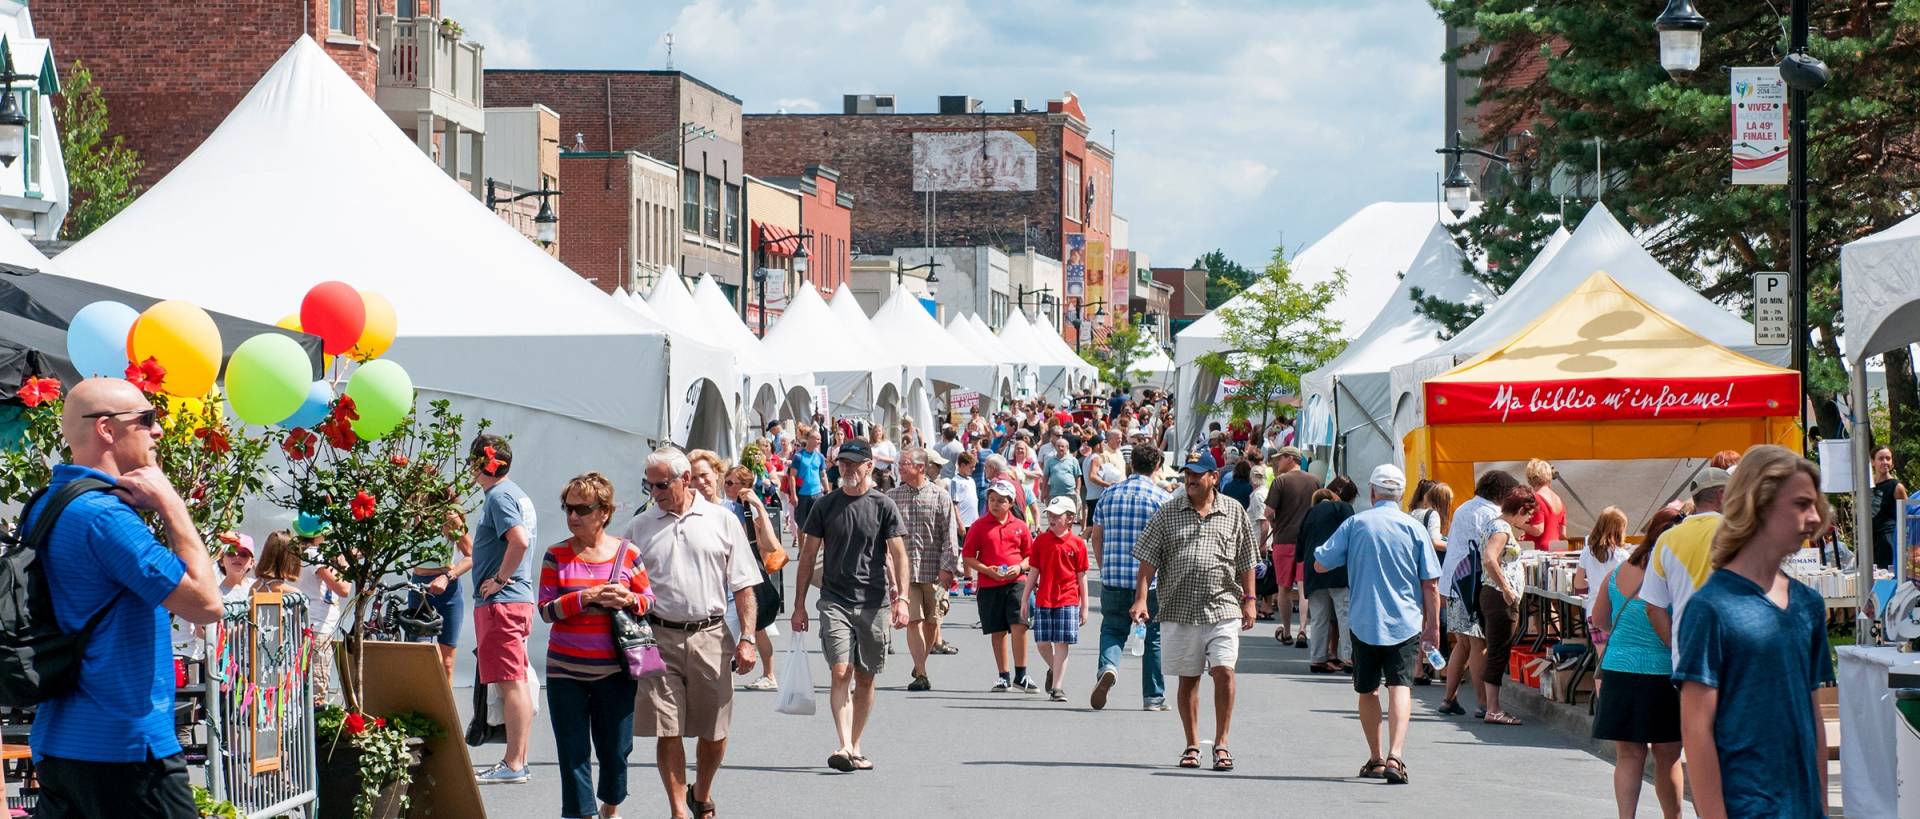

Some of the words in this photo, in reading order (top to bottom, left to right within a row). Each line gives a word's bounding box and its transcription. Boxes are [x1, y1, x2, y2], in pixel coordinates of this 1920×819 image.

[1747, 103, 1772, 111] VIVEZ
[1746, 121, 1757, 130] LA
[1743, 132, 1772, 140] FINALE
[1767, 277, 1779, 292] P
[1488, 383, 1524, 423] Ma
[1528, 386, 1596, 413] biblio
[1601, 382, 1735, 417] m'informe!
